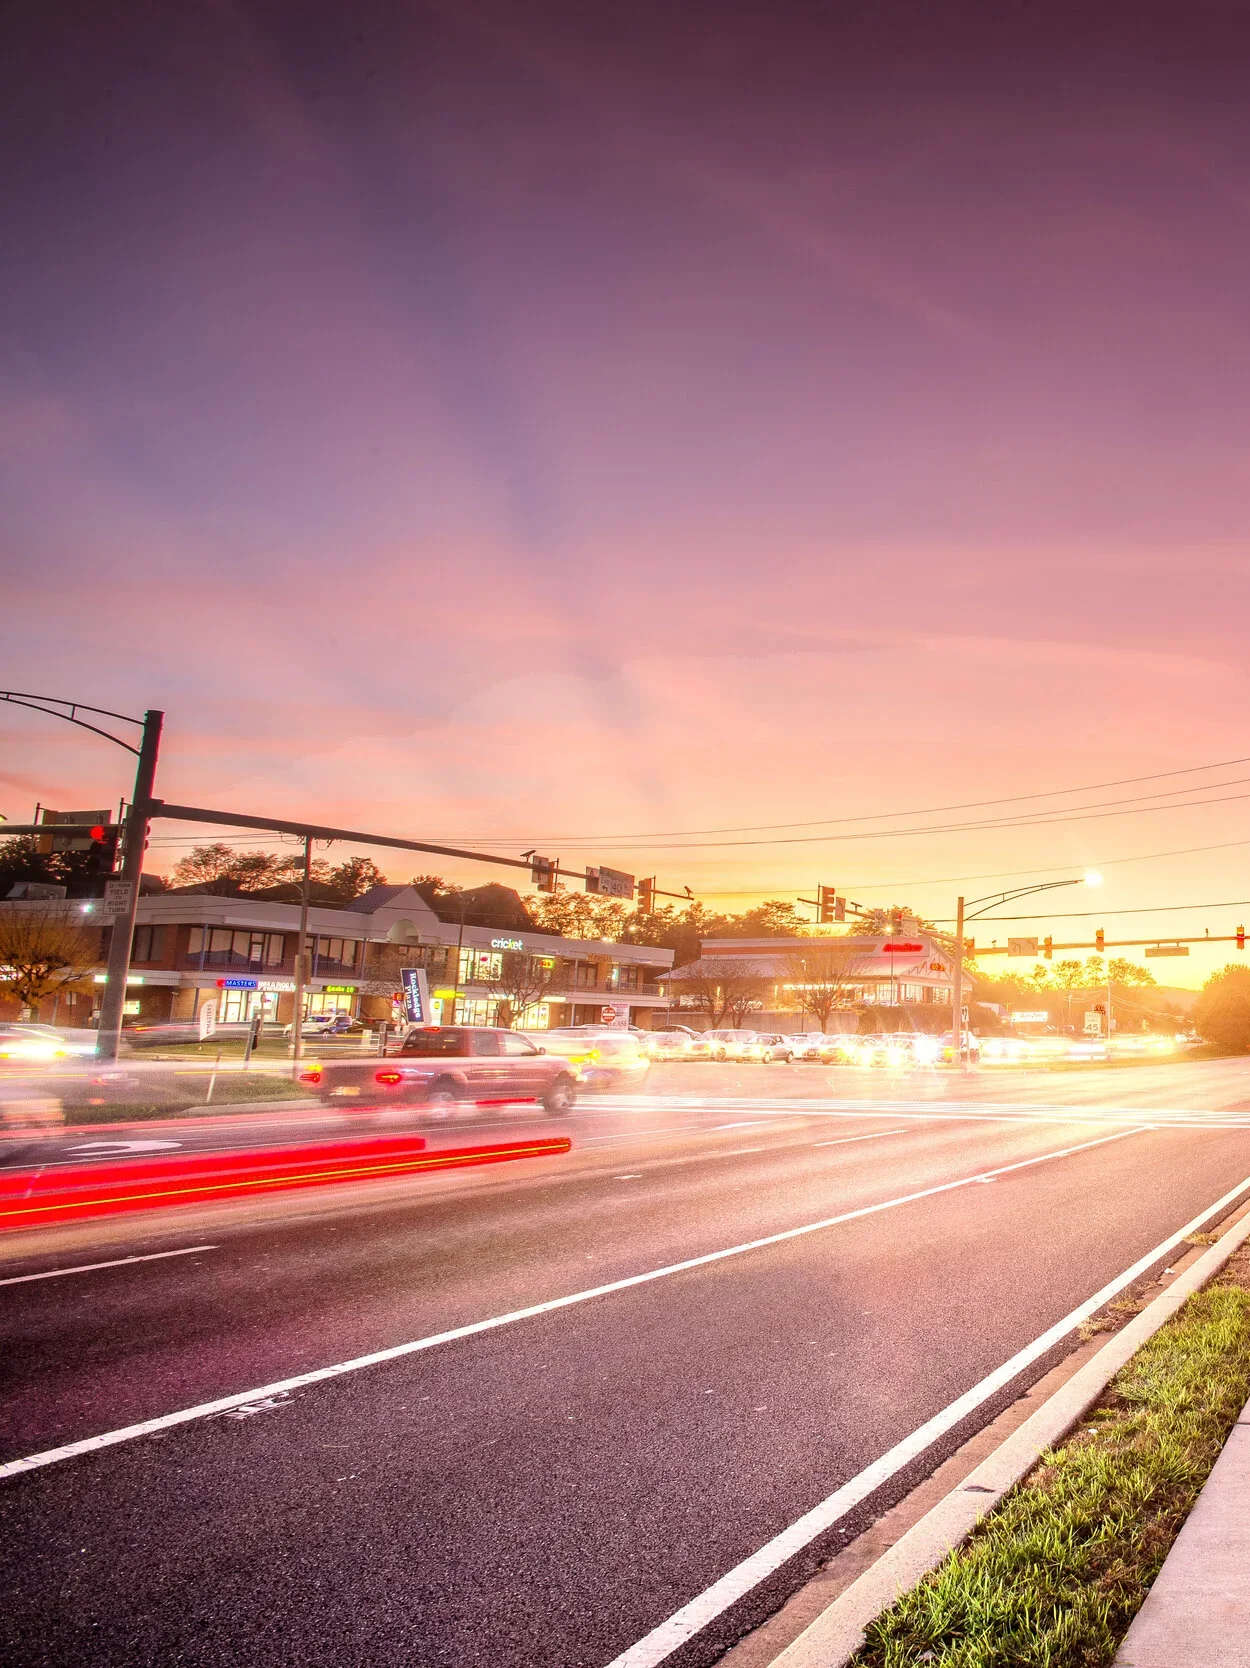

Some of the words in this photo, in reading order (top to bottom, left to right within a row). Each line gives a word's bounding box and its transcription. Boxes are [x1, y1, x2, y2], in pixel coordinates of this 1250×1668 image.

[491, 938, 523, 950] cricket
[410, 972, 421, 1018] Rockledge
[1086, 1023, 1099, 1031] 45
